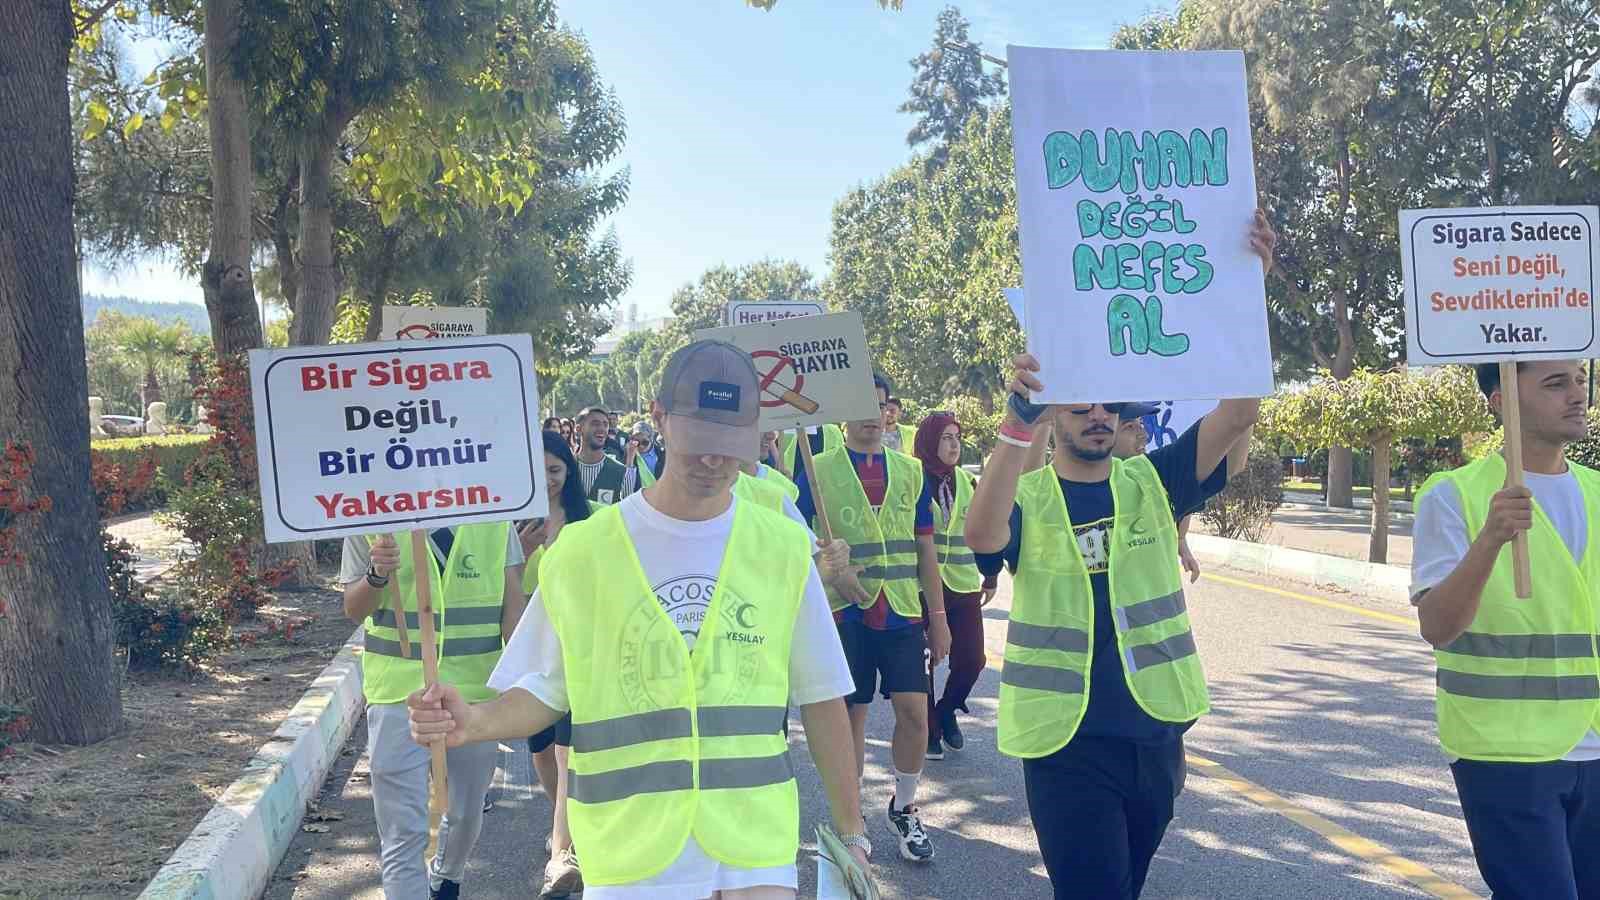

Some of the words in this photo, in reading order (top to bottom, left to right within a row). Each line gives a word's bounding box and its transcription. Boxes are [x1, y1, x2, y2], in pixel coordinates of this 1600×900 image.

[1043, 128, 1228, 194] DUMAN
[1077, 194, 1197, 239] DEĞİL
[1432, 223, 1506, 249] Sigara
[1510, 221, 1582, 242] Sadece
[1073, 241, 1213, 294] NEFES
[1453, 255, 1501, 277] Seni
[1507, 253, 1566, 280] Değil,
[1430, 287, 1589, 312] Sevdiklerini'de
[739, 311, 763, 323] Her
[1107, 294, 1190, 356] AL
[1480, 323, 1548, 344] Yakar.
[301, 363, 358, 392] Bir
[367, 358, 492, 391] Sigara
[792, 353, 850, 375] HAYIR
[344, 399, 458, 433] Değil,
[319, 448, 376, 477] Bir
[386, 437, 492, 470] Ömür
[315, 485, 502, 520] Yakarsın.
